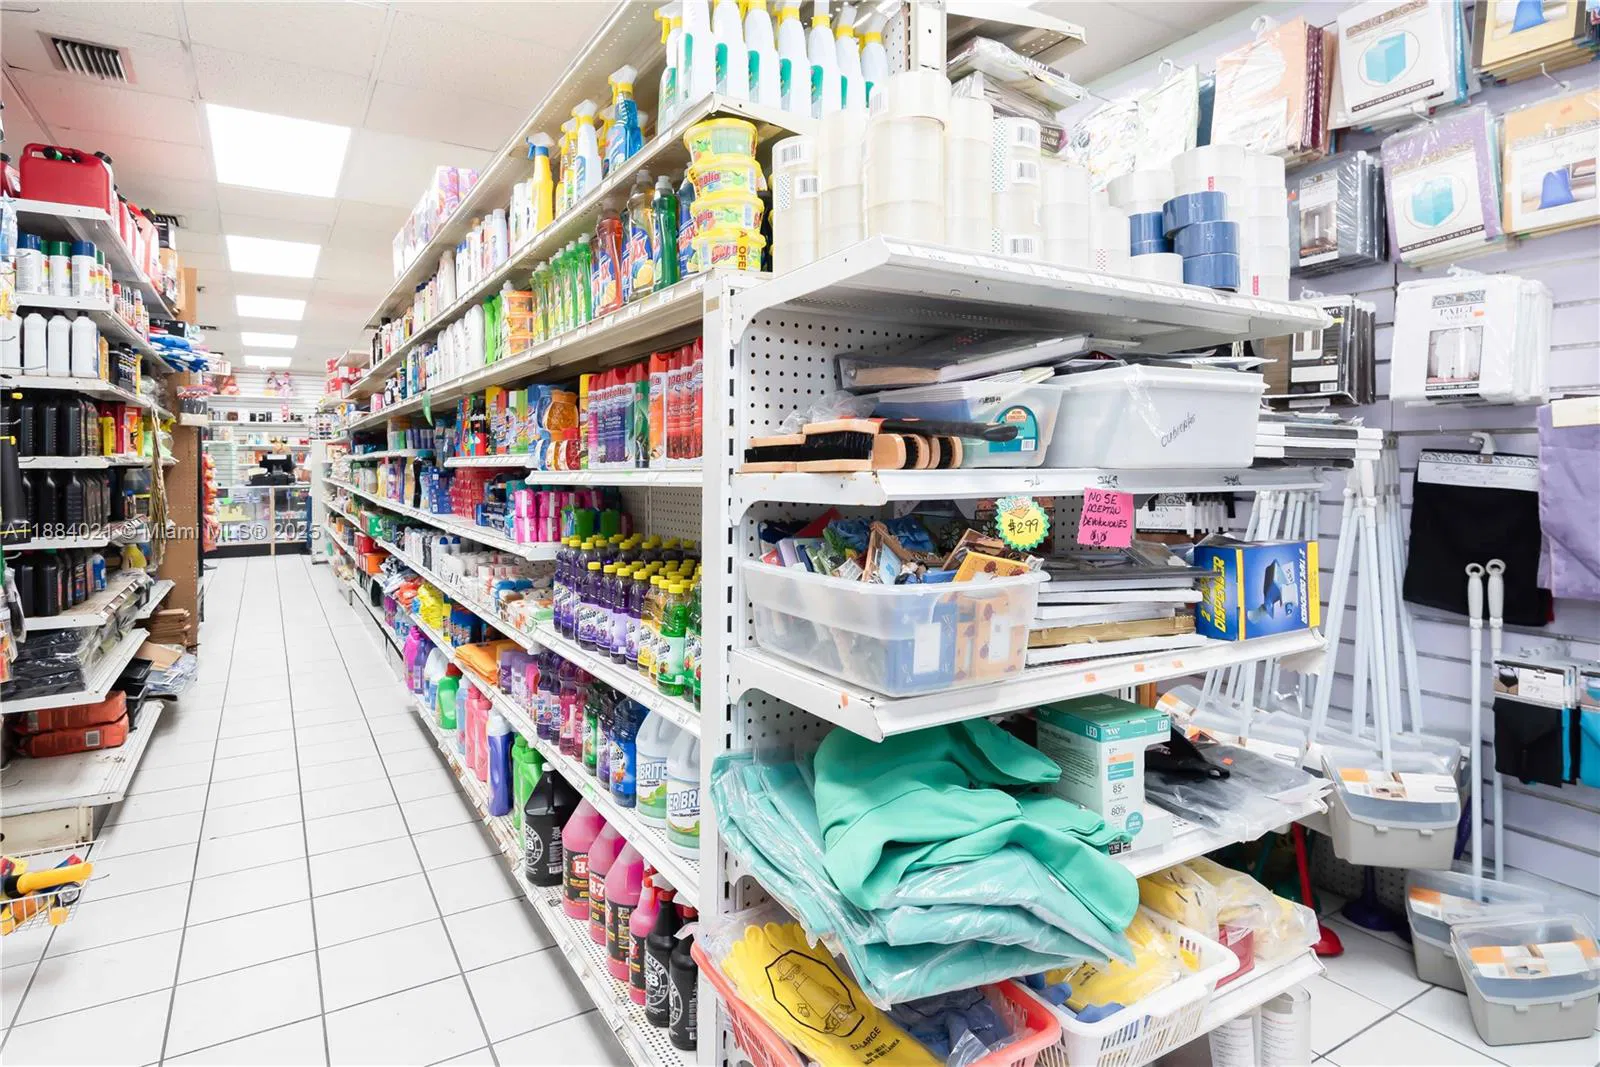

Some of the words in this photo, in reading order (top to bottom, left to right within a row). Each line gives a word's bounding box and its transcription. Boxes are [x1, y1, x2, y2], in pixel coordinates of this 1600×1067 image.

[738, 246, 747, 270] OFE
[1088, 492, 1102, 502] NO
[1104, 494, 1118, 505] SE
[1085, 724, 1098, 738] LED
[1156, 719, 1169, 732] LED
